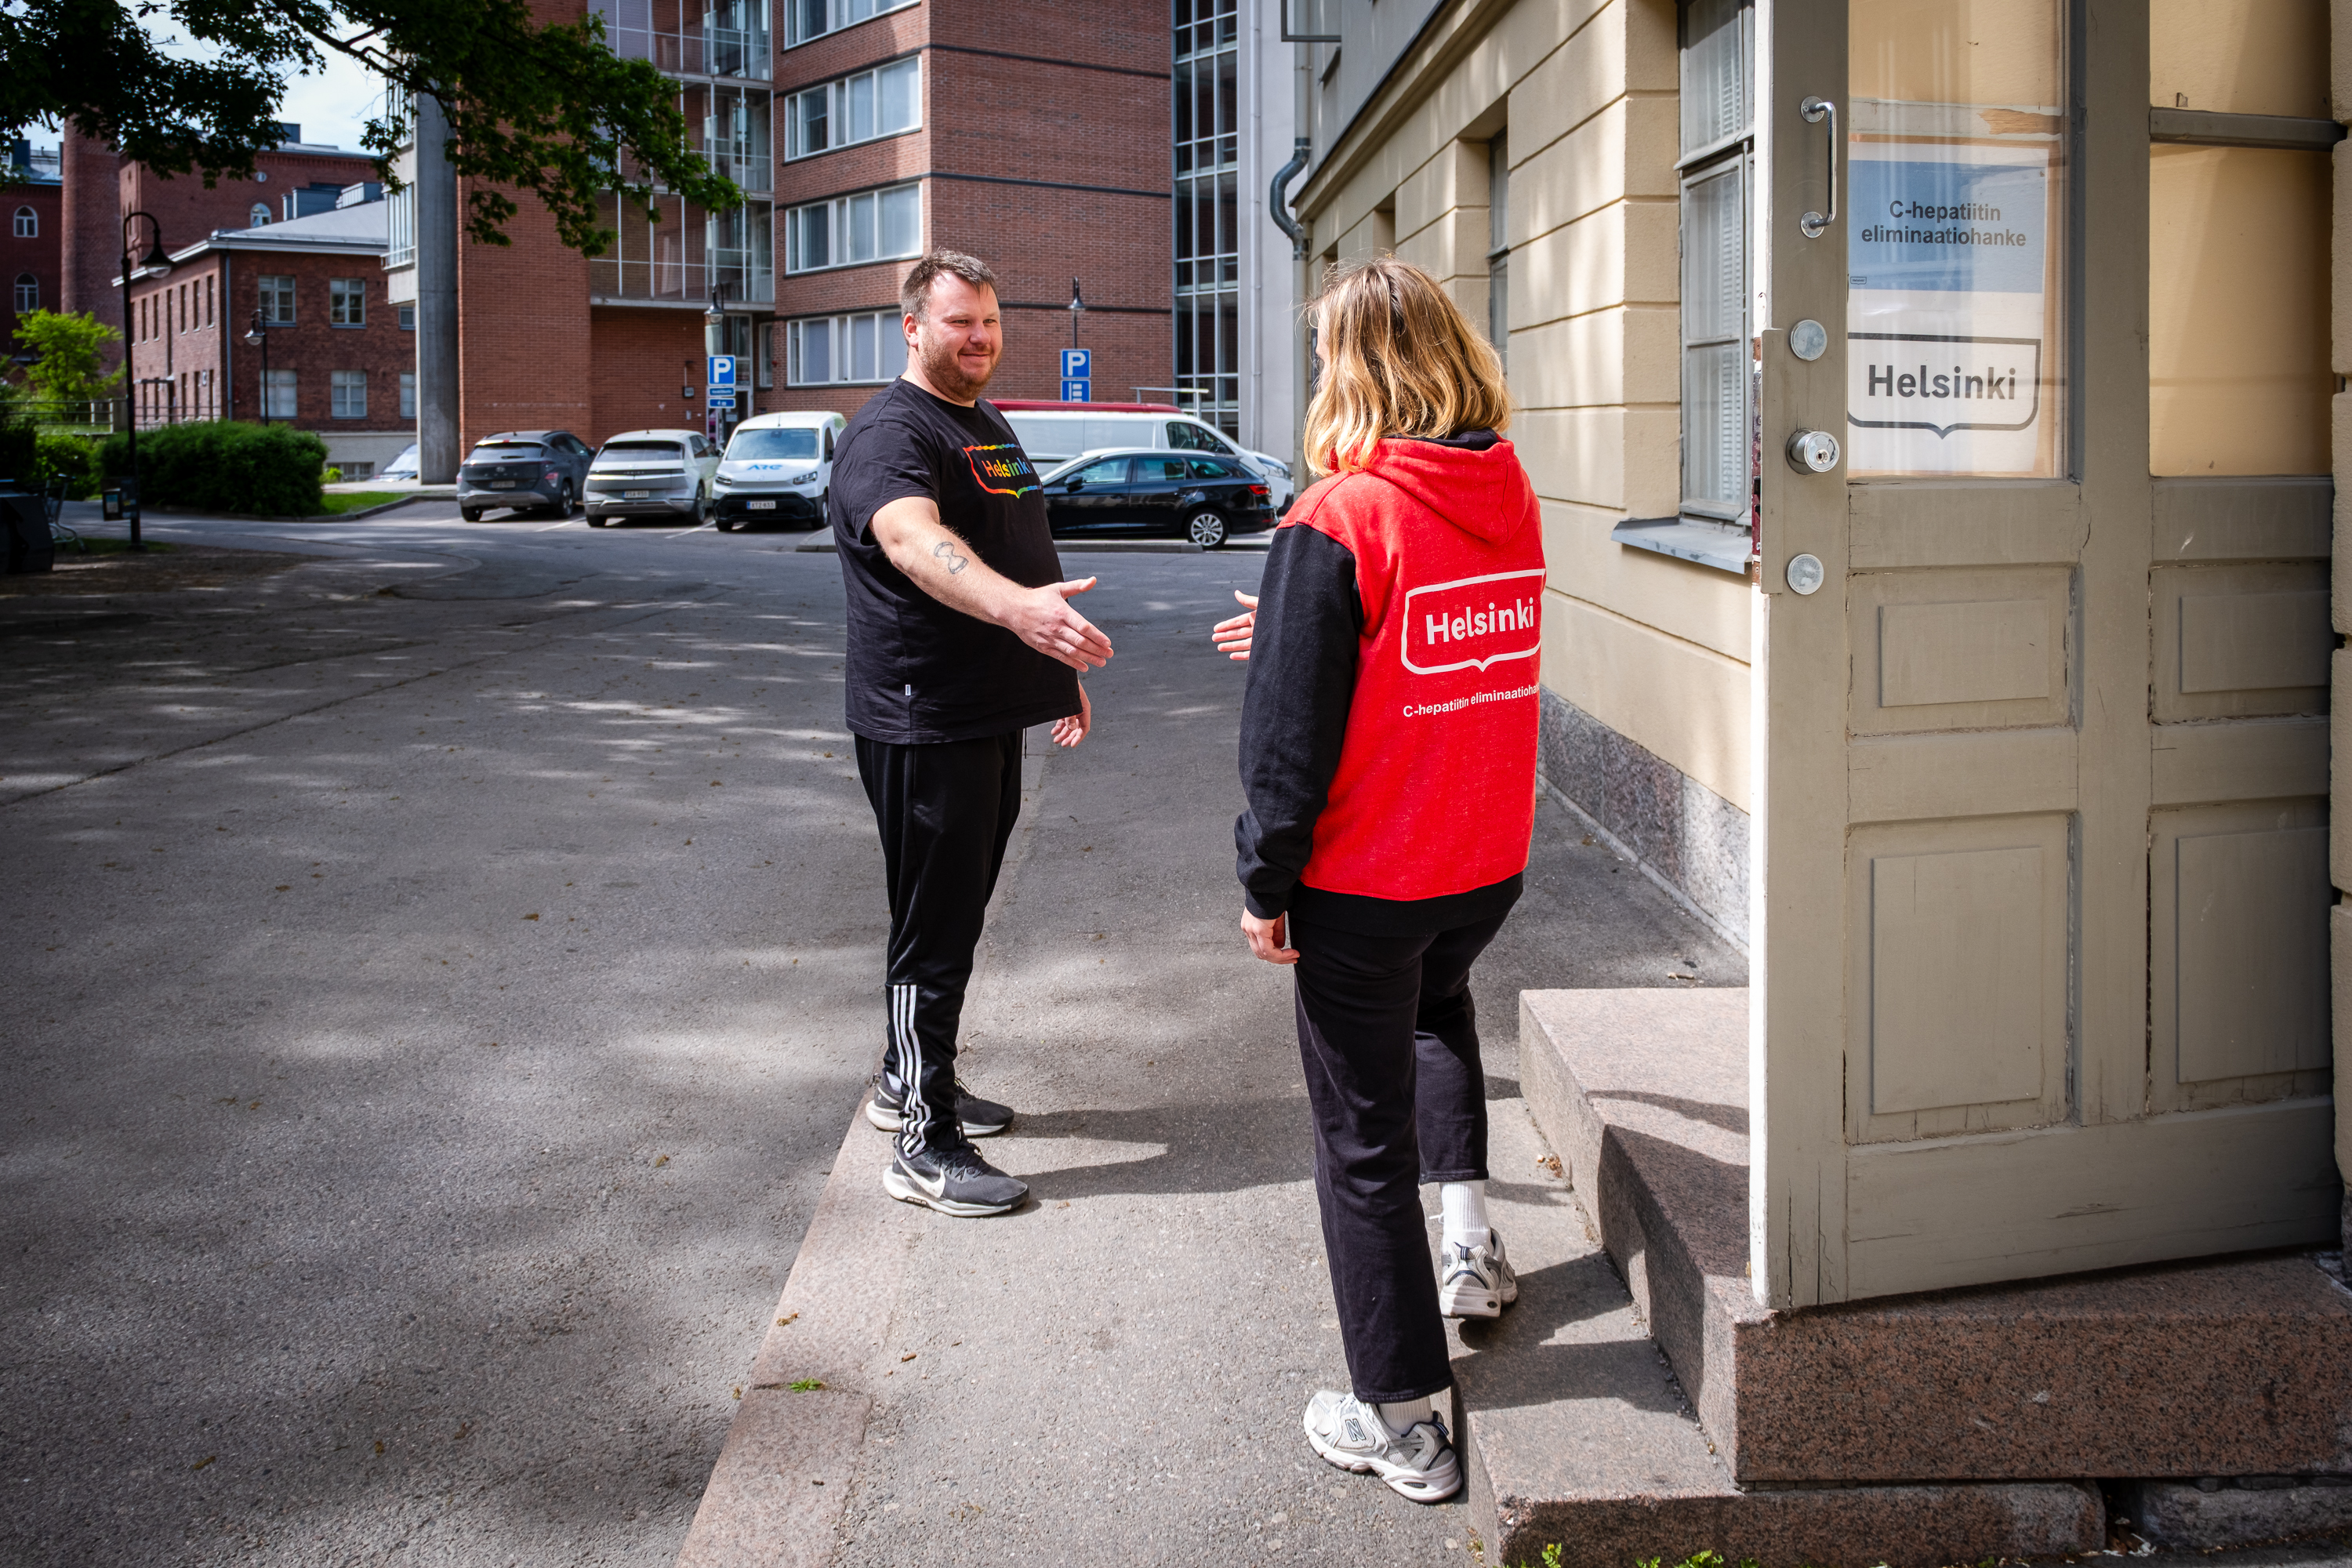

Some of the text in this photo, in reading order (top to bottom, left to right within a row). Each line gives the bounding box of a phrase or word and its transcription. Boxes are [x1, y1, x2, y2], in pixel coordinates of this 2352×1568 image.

[1889, 200, 2001, 223] C-hepatiitin
[1861, 224, 2027, 246] eliminaatiohanke
[713, 358, 731, 383] P
[1067, 351, 1087, 376] P
[1868, 364, 2016, 400] Helsinki
[1425, 597, 1534, 645] Helsinki
[1403, 681, 1540, 717] C-hepatiitin eliminaatioha
[1345, 1418, 1367, 1442] N
